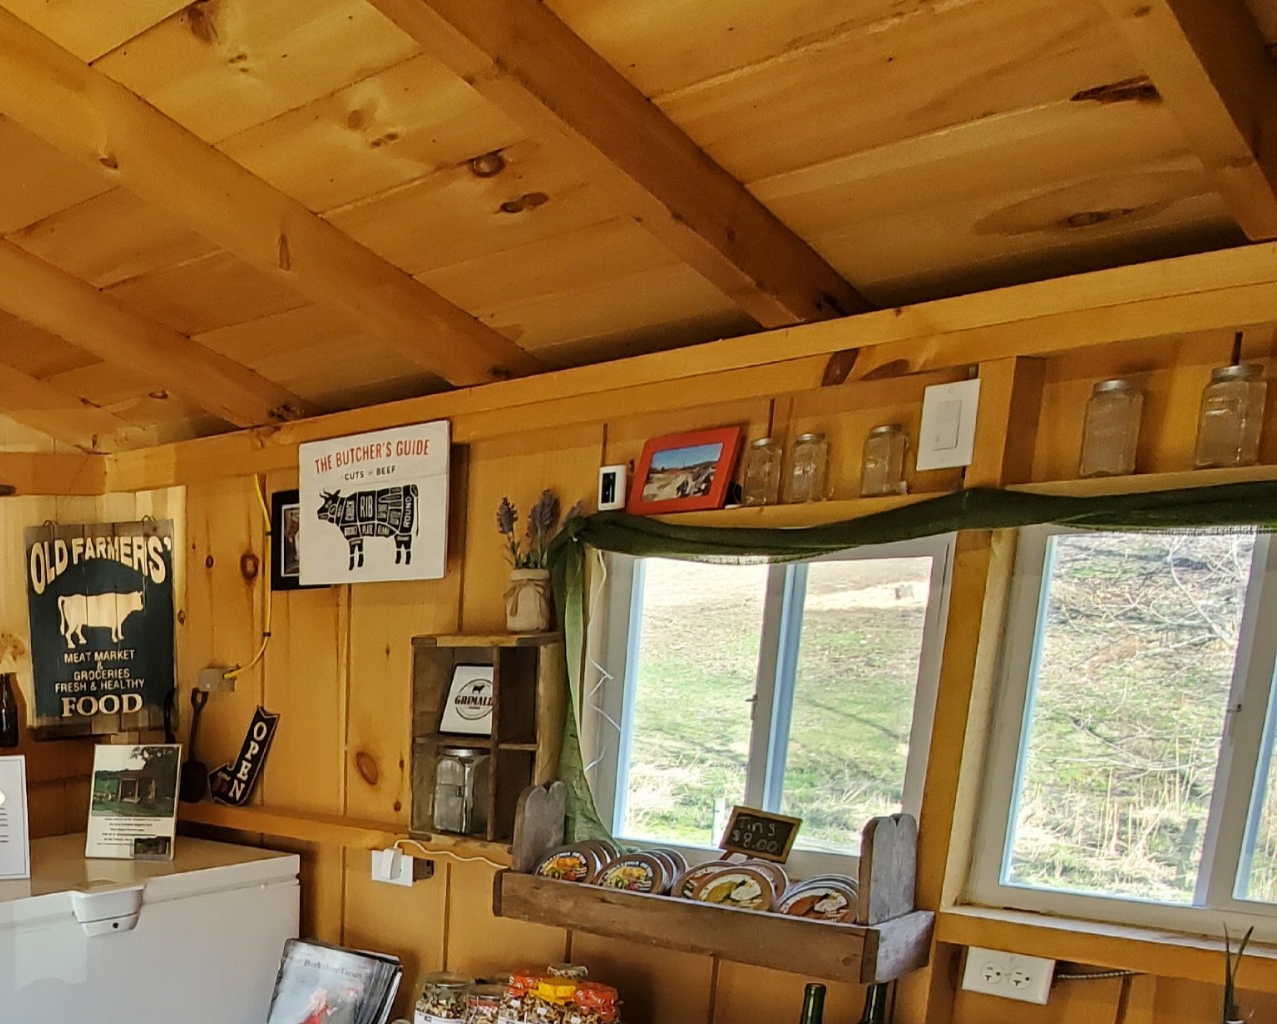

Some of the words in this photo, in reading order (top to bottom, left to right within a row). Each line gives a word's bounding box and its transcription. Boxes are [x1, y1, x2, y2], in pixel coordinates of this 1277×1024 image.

[314, 454, 333, 474] THE
[336, 443, 392, 466] BUTCHER'S
[396, 439, 431, 456] GUIDE
[344, 470, 364, 481] CUTS
[376, 465, 396, 476] BEEF
[360, 495, 373, 518] RIB
[403, 497, 413, 528] ROUND
[30, 538, 69, 595] OLD
[71, 535, 172, 584] FARMERS'
[64, 651, 91, 663] MEAT
[94, 649, 135, 662] MARKET
[55, 682, 87, 693] FRESH
[90, 682, 97, 691] &
[100, 679, 145, 690] HEALTHY
[73, 668, 130, 681] GROCERIES
[61, 693, 143, 718] FOOD
[228, 721, 267, 801] OPEN
[732, 829, 778, 852] $8.00
